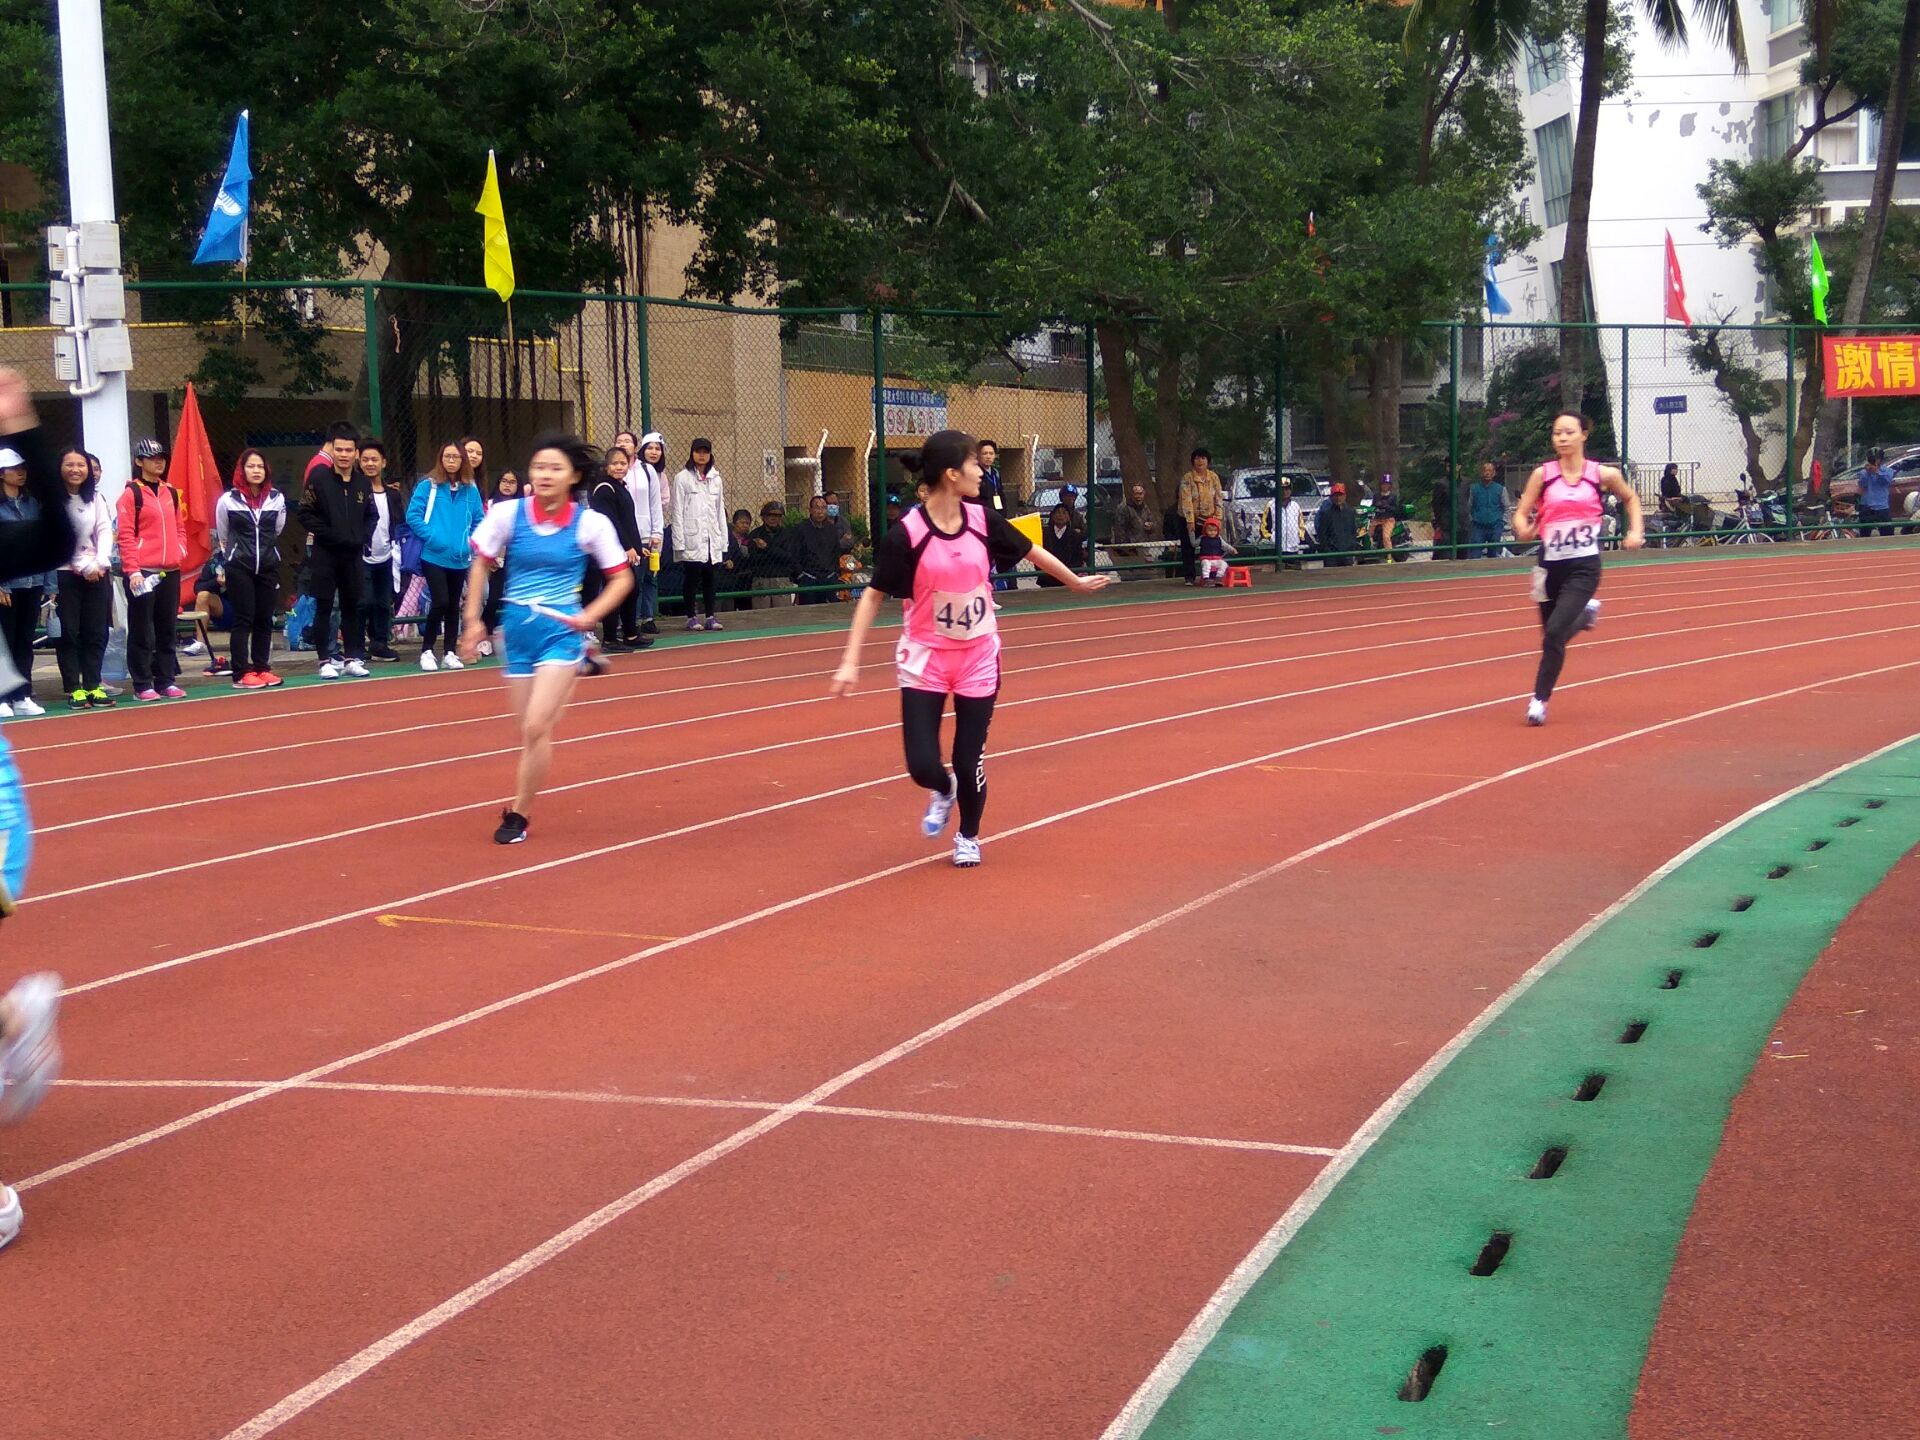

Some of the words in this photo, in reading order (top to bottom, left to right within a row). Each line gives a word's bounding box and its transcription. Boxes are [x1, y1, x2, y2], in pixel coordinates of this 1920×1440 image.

[1833, 341, 1920, 390] 激情
[1549, 525, 1594, 552] 443
[936, 596, 987, 631] 449
